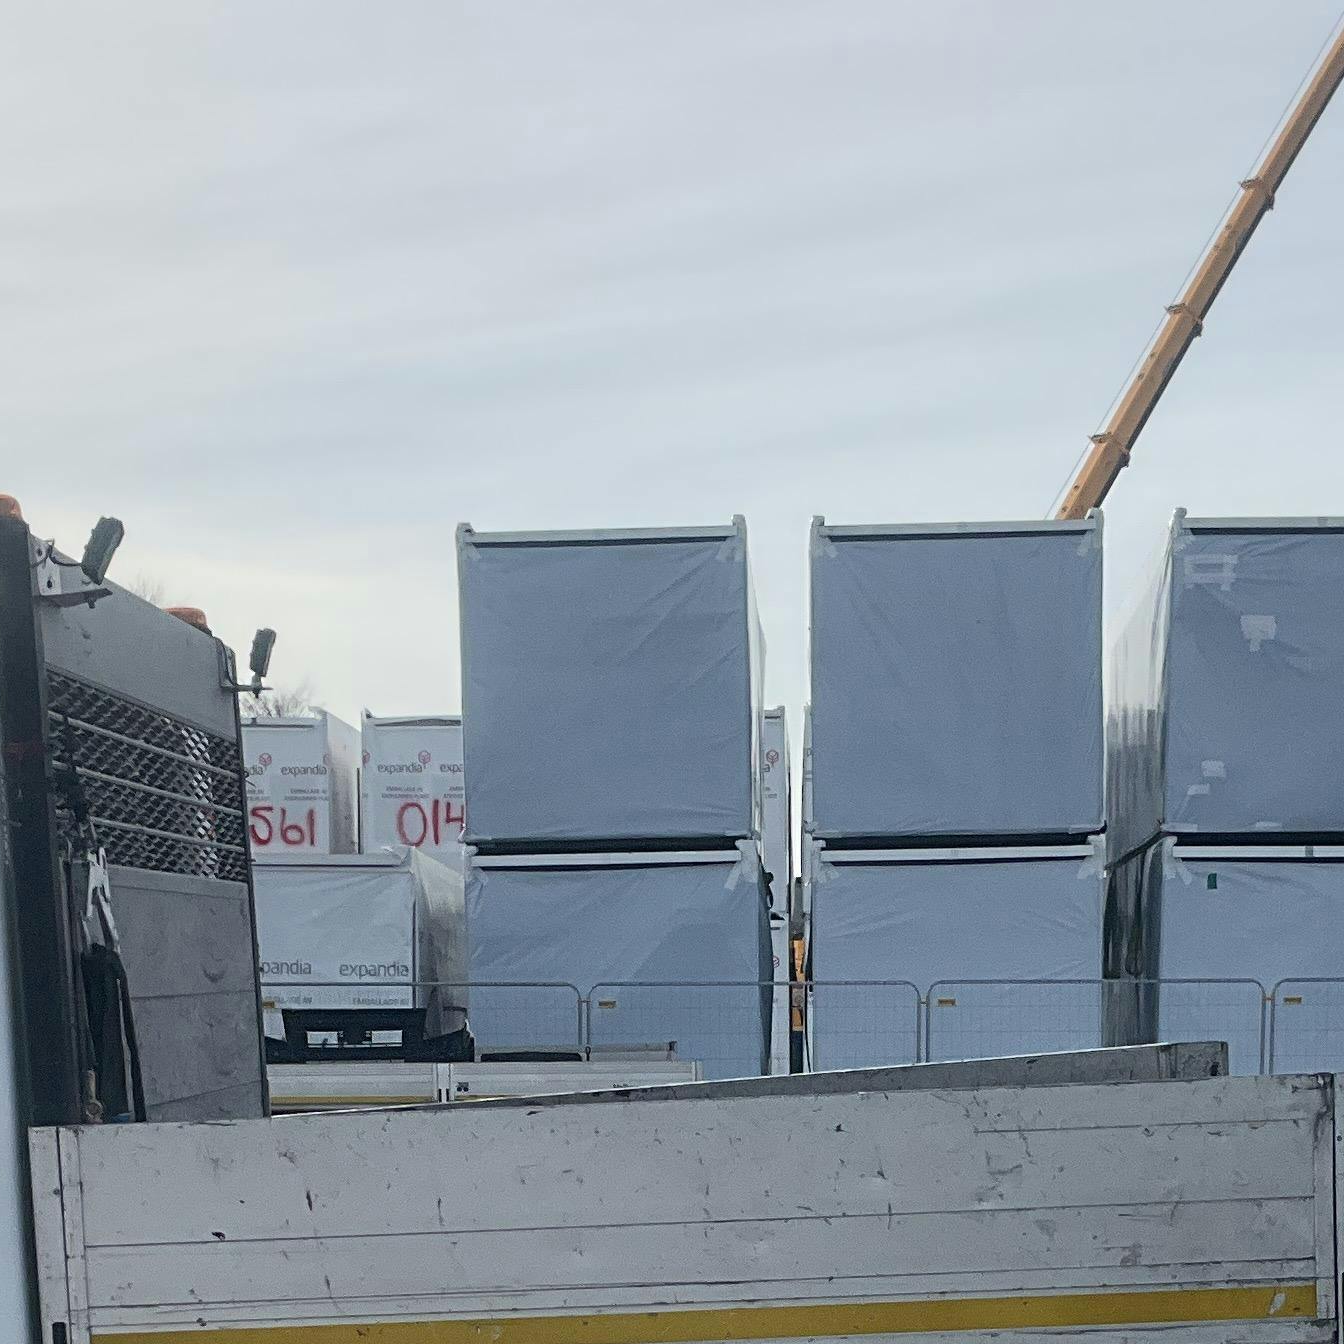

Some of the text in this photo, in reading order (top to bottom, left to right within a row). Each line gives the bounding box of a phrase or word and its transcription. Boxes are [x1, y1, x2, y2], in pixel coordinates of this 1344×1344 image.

[281, 765, 327, 777] expandia
[377, 762, 423, 775] expandia
[249, 806, 316, 846] 561
[396, 799, 465, 847] 014
[339, 961, 409, 979] expandia
